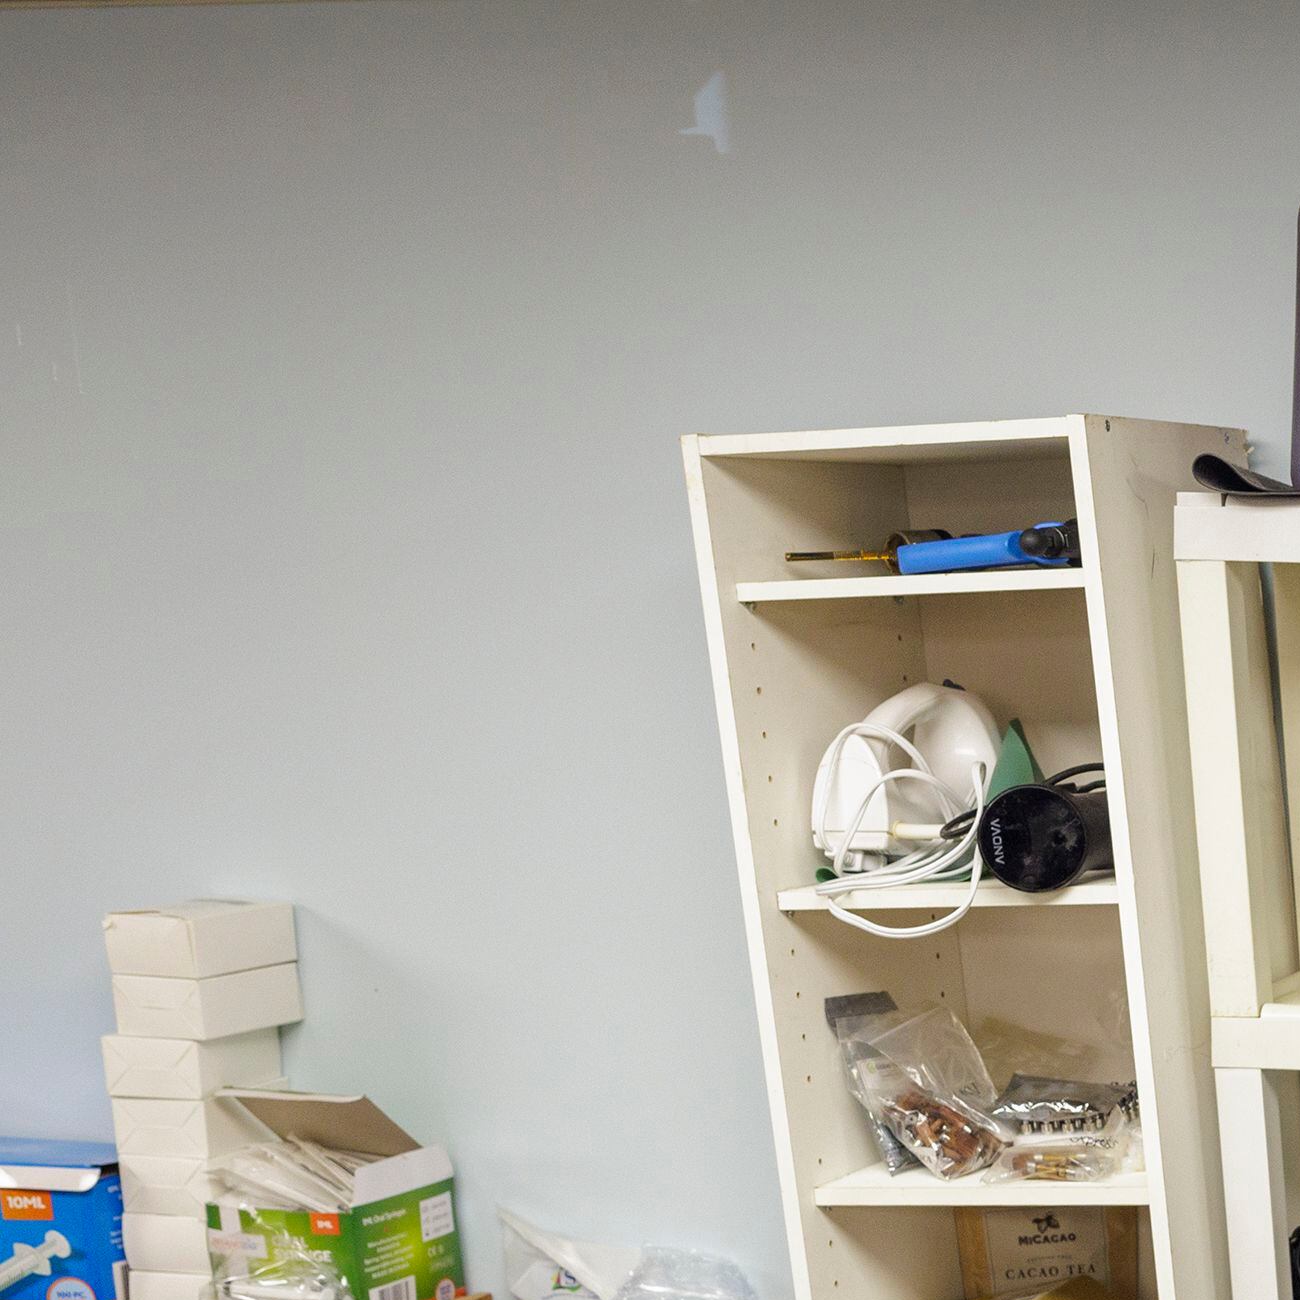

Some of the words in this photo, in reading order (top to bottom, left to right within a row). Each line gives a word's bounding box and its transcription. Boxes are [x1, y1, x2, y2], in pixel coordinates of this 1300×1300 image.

[990, 818, 1006, 865] ANOVA
[6, 1195, 46, 1210] 10ML
[1004, 1264, 1060, 1280] CACAO
[1066, 1263, 1096, 1275] TEA
